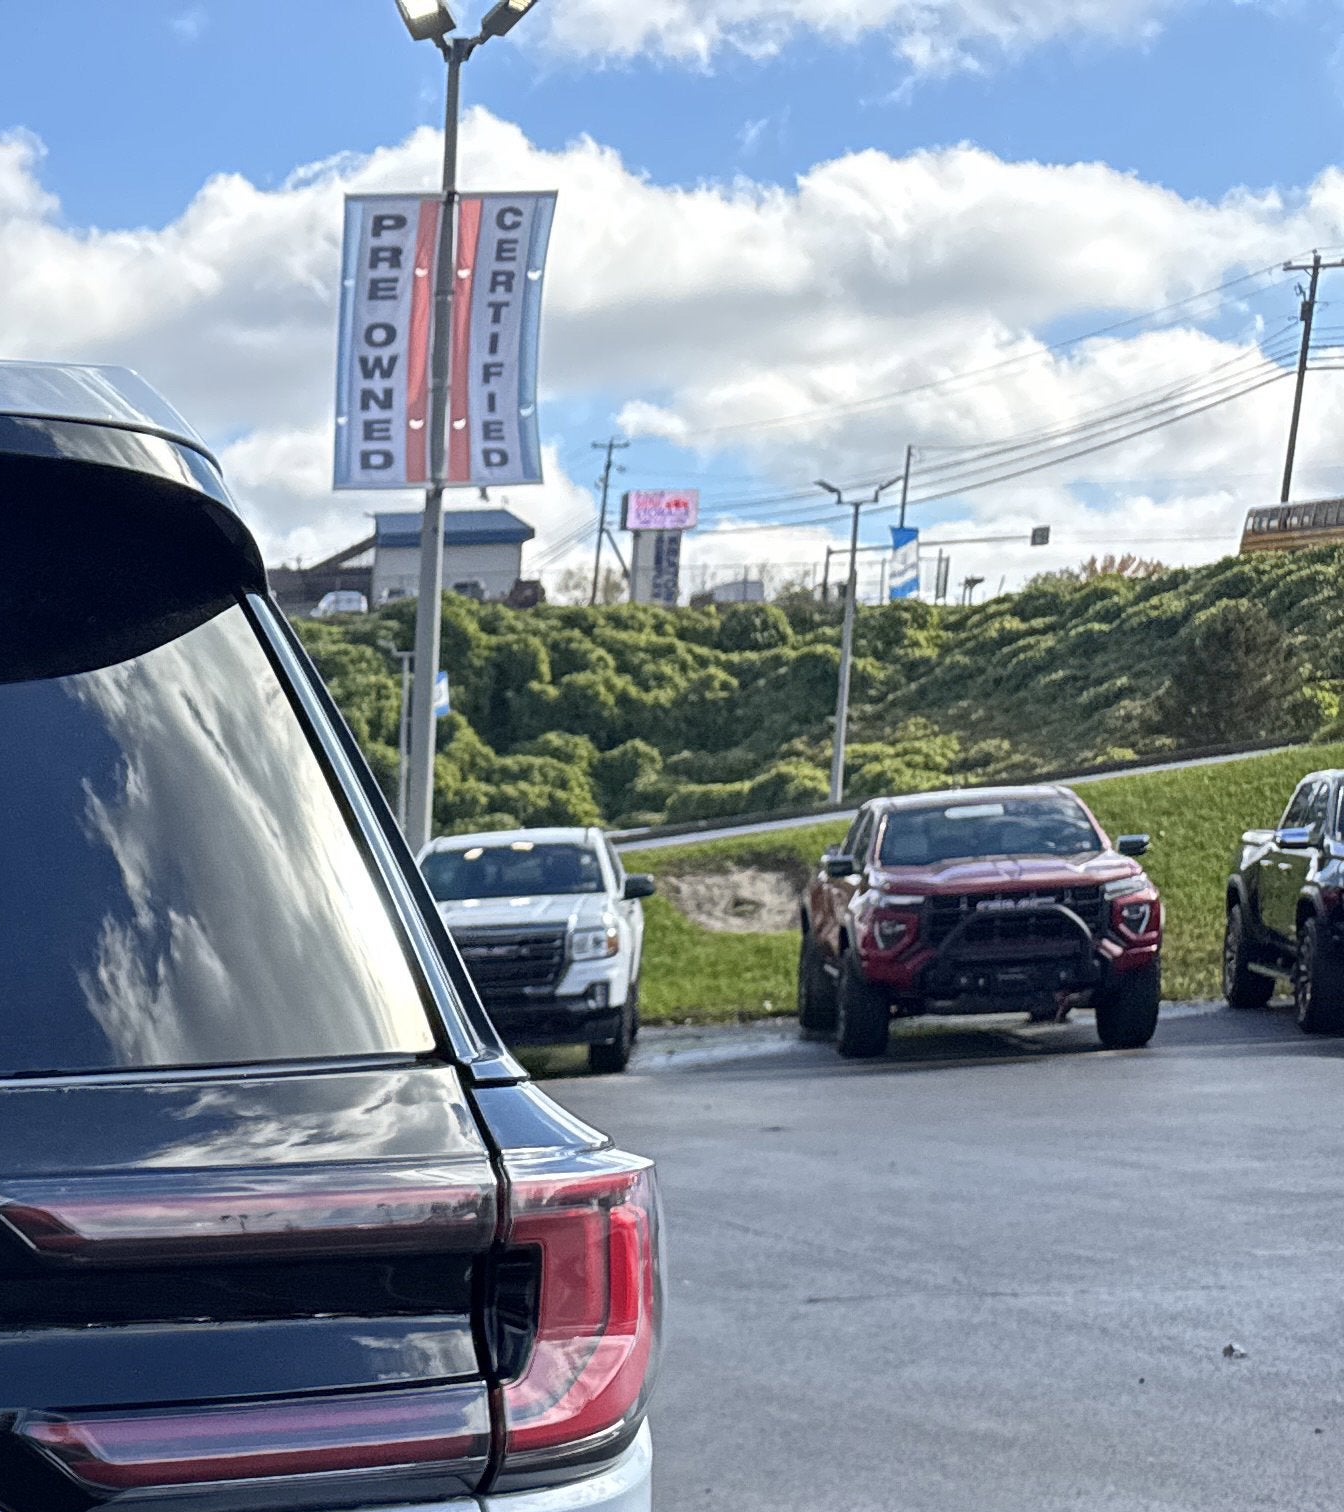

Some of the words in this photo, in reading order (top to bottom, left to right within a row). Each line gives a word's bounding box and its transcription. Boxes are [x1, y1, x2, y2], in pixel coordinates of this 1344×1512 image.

[366, 213, 408, 302] PRE
[358, 322, 400, 470] OWNED
[481, 207, 524, 468] CERTIFIED
